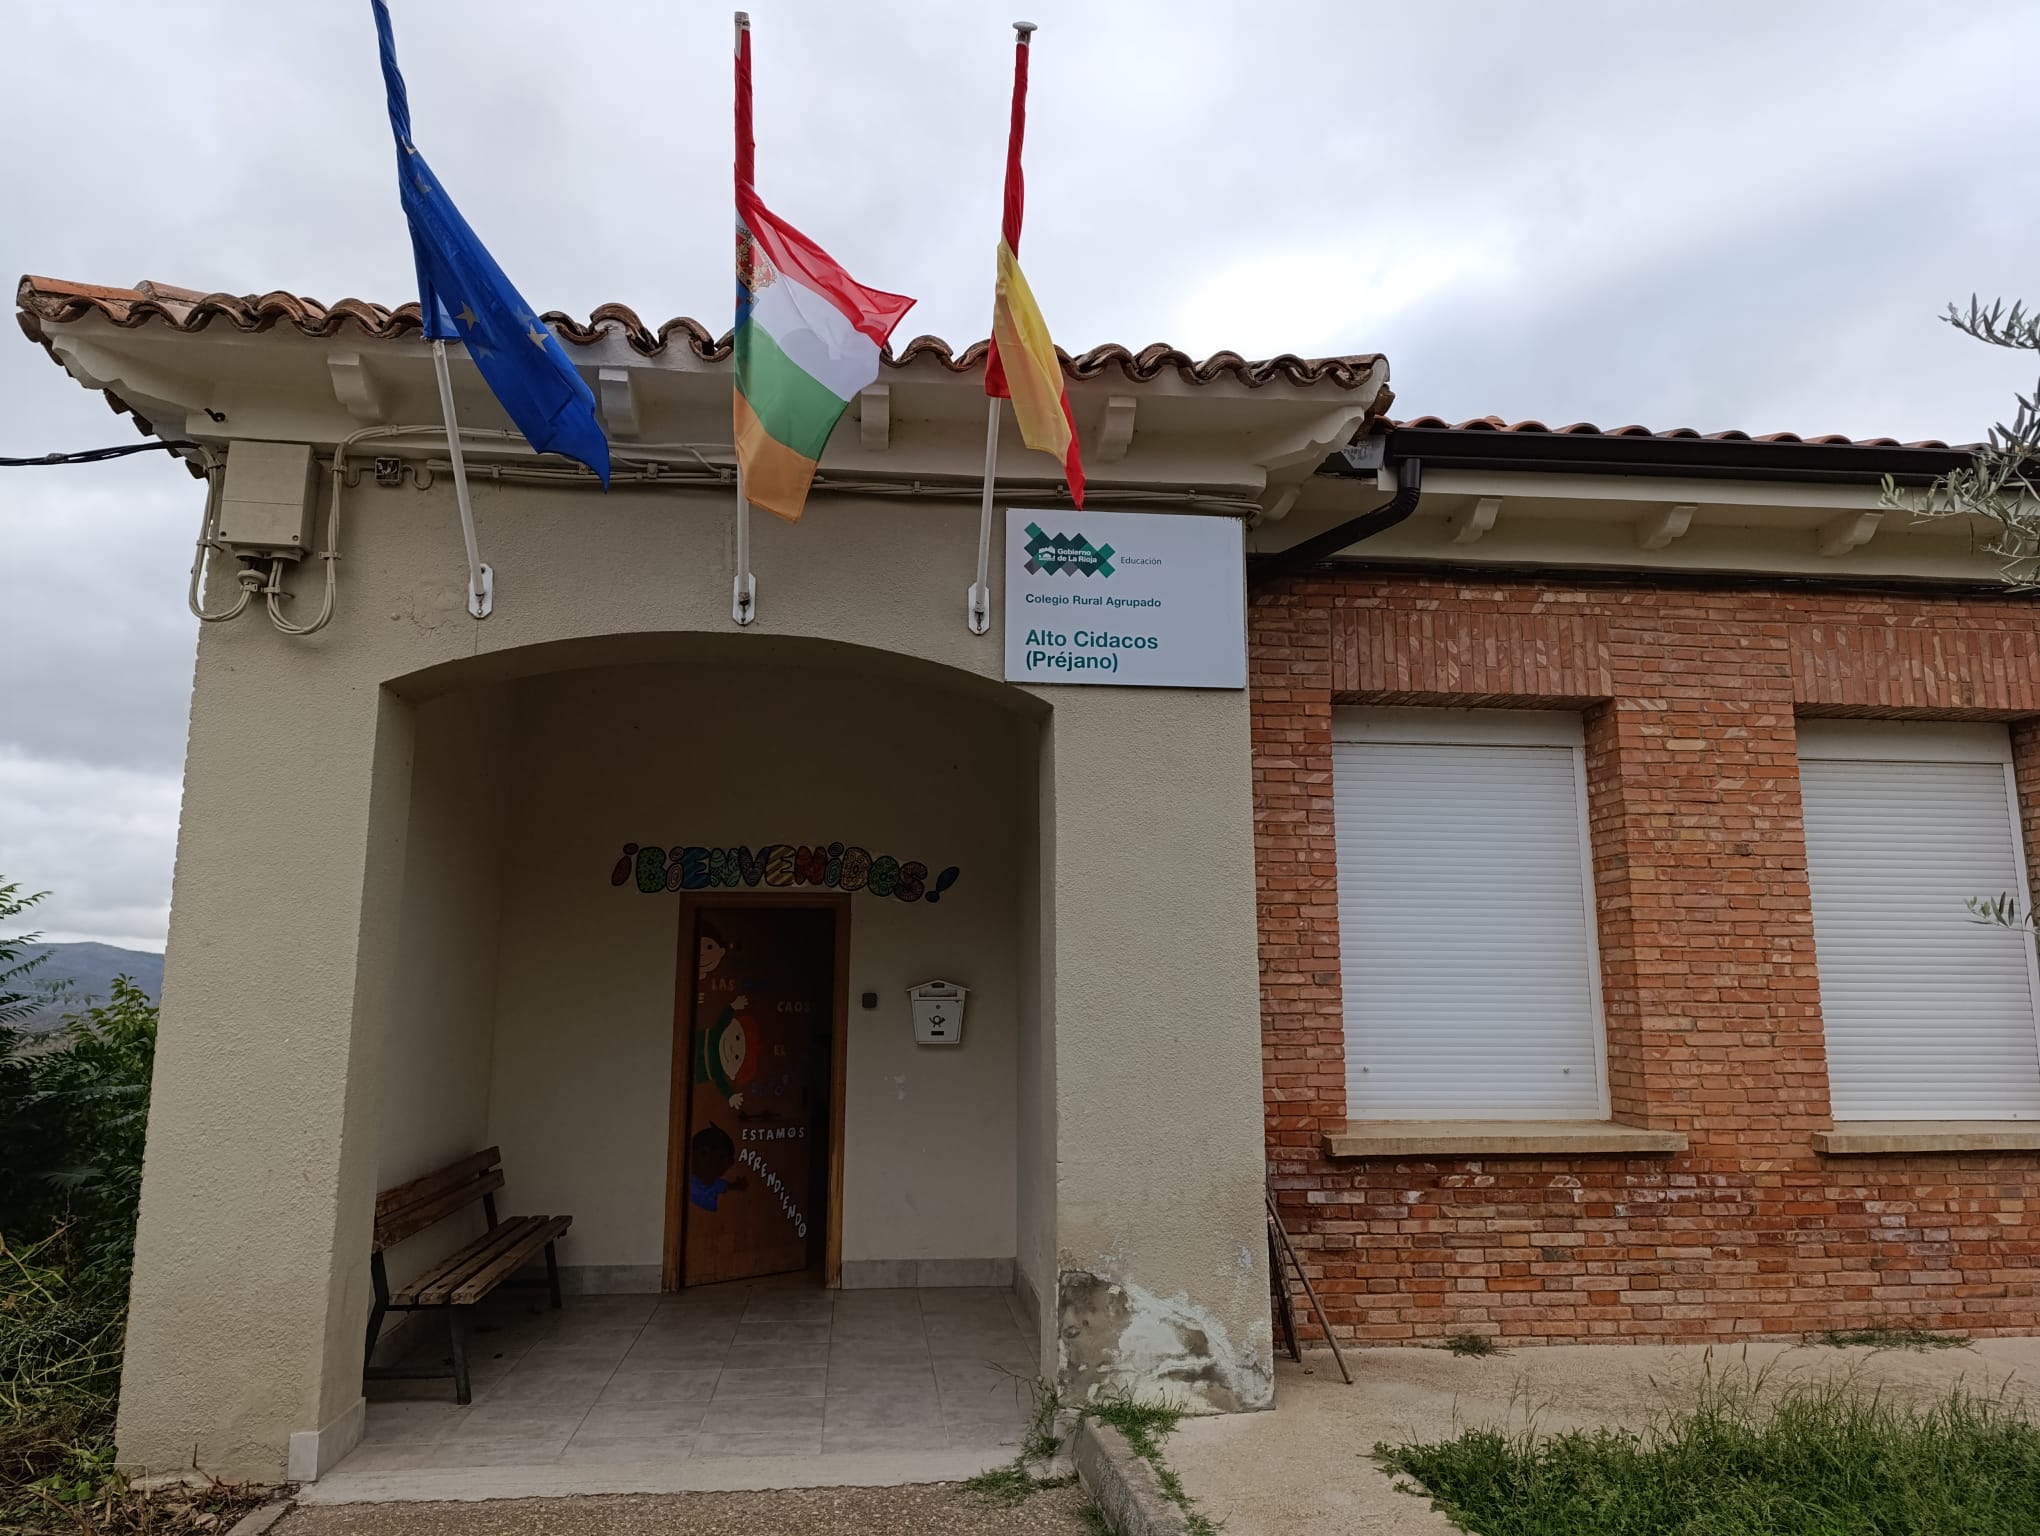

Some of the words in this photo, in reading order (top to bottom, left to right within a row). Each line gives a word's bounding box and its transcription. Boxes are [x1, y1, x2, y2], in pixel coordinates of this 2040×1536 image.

[1057, 548, 1092, 556] Gobierno
[1078, 555, 1098, 564] Rioja
[1120, 556, 1162, 565] Educación
[1025, 593, 1069, 606] Colegio
[1072, 595, 1103, 606] Rural
[1106, 596, 1162, 609] Agrupado
[1025, 629, 1067, 647] Alto
[1073, 631, 1159, 649] Cidacos
[1025, 650, 1119, 673] (Préjano)
[741, 1126, 806, 1141] ESTAMOS
